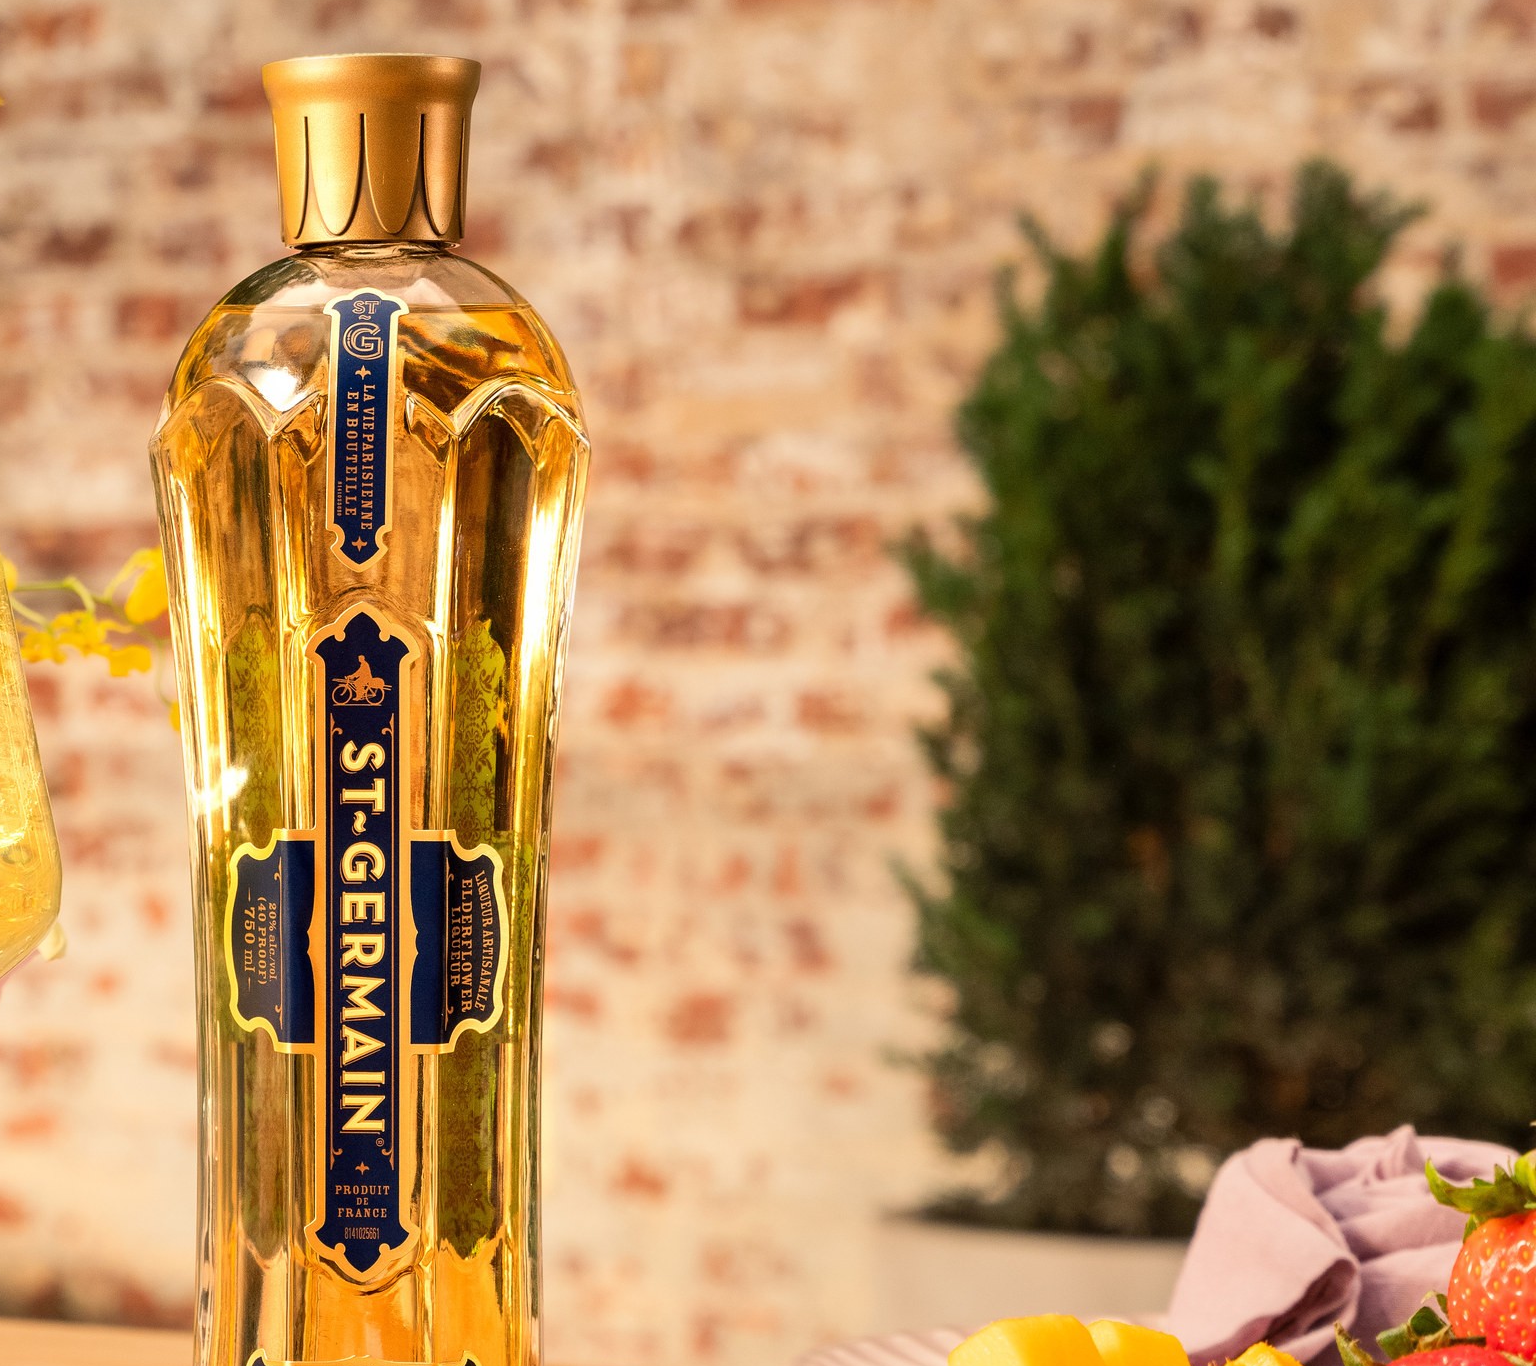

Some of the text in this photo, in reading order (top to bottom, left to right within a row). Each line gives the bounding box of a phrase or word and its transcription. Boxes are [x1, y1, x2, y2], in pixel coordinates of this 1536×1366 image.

[342, 322, 384, 361] G
[344, 391, 359, 517] EN BOUTEILLE
[360, 384, 376, 531] LA VIE PARISIENNE
[244, 906, 256, 973] 750 ml
[257, 896, 268, 985] (40 PROOF)
[268, 902, 278, 932] 20%
[450, 906, 461, 987] LIQUEUR
[461, 878, 474, 1013] ELDERFLOWER
[474, 869, 494, 1012] LIQUEUR ARTISANALE
[335, 1185, 390, 1196] PRODUIT
[337, 1208, 387, 1218] FRANCE
[356, 1197, 369, 1206] DE
